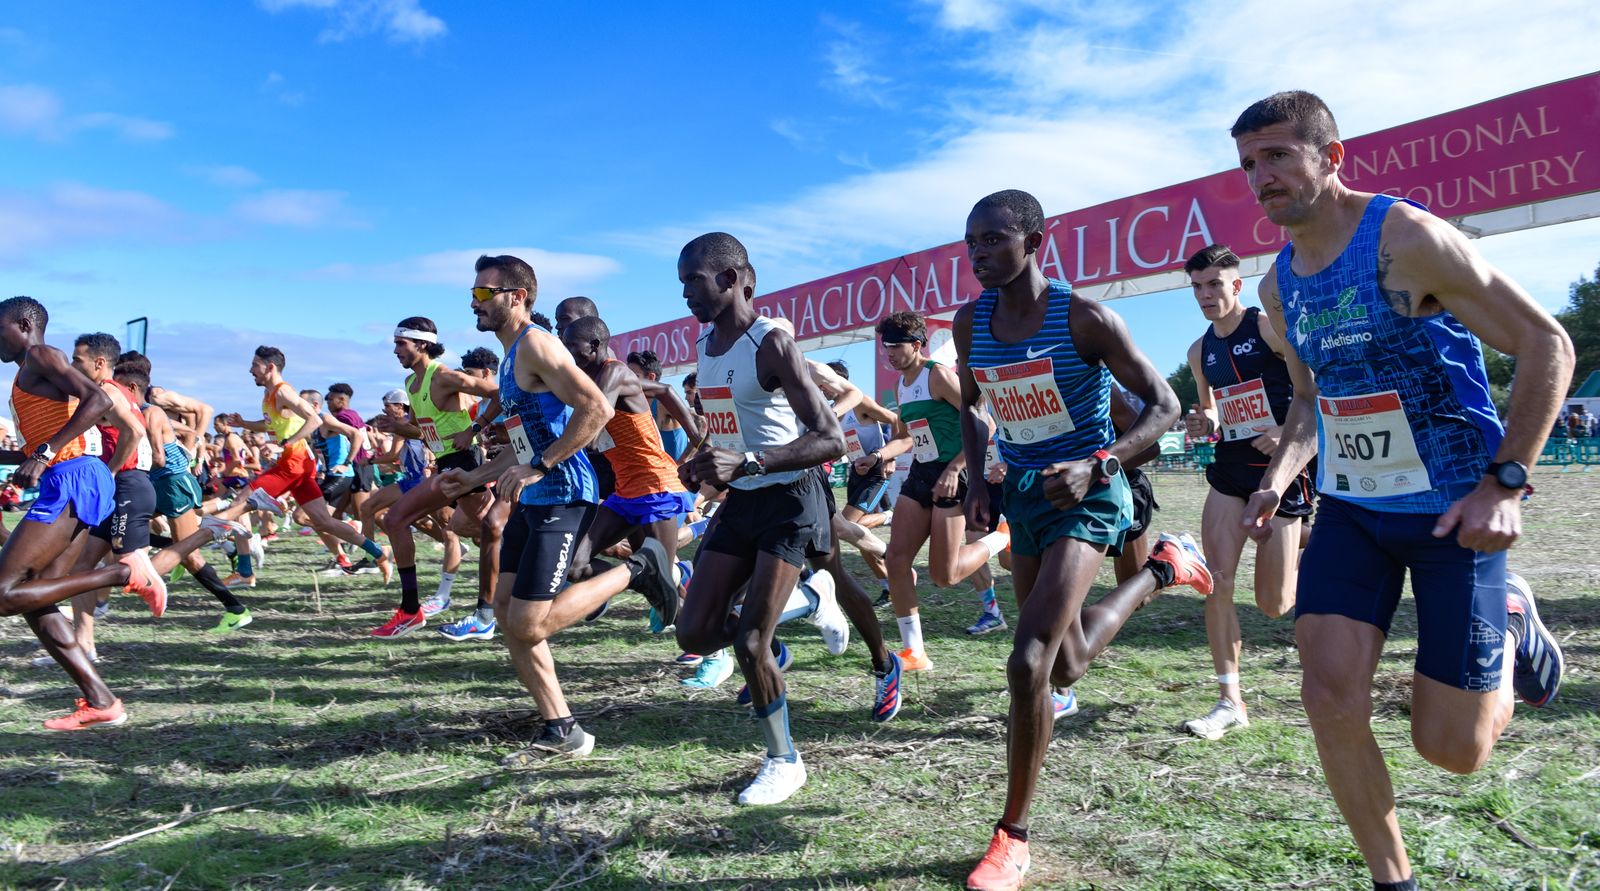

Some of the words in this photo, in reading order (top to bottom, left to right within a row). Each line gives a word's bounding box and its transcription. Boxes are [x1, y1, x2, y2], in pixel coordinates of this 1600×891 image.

[1341, 105, 1560, 182] NATIONAL
[1379, 151, 1585, 213] OUNTRY
[1040, 197, 1215, 285] ÁLICA
[1233, 343, 1252, 355] GO
[1321, 332, 1372, 351] Atletismo
[985, 383, 1062, 422] Waithaka
[1222, 394, 1269, 425] JIMENEZ
[513, 436, 526, 454] 14
[1335, 430, 1391, 461] 1607
